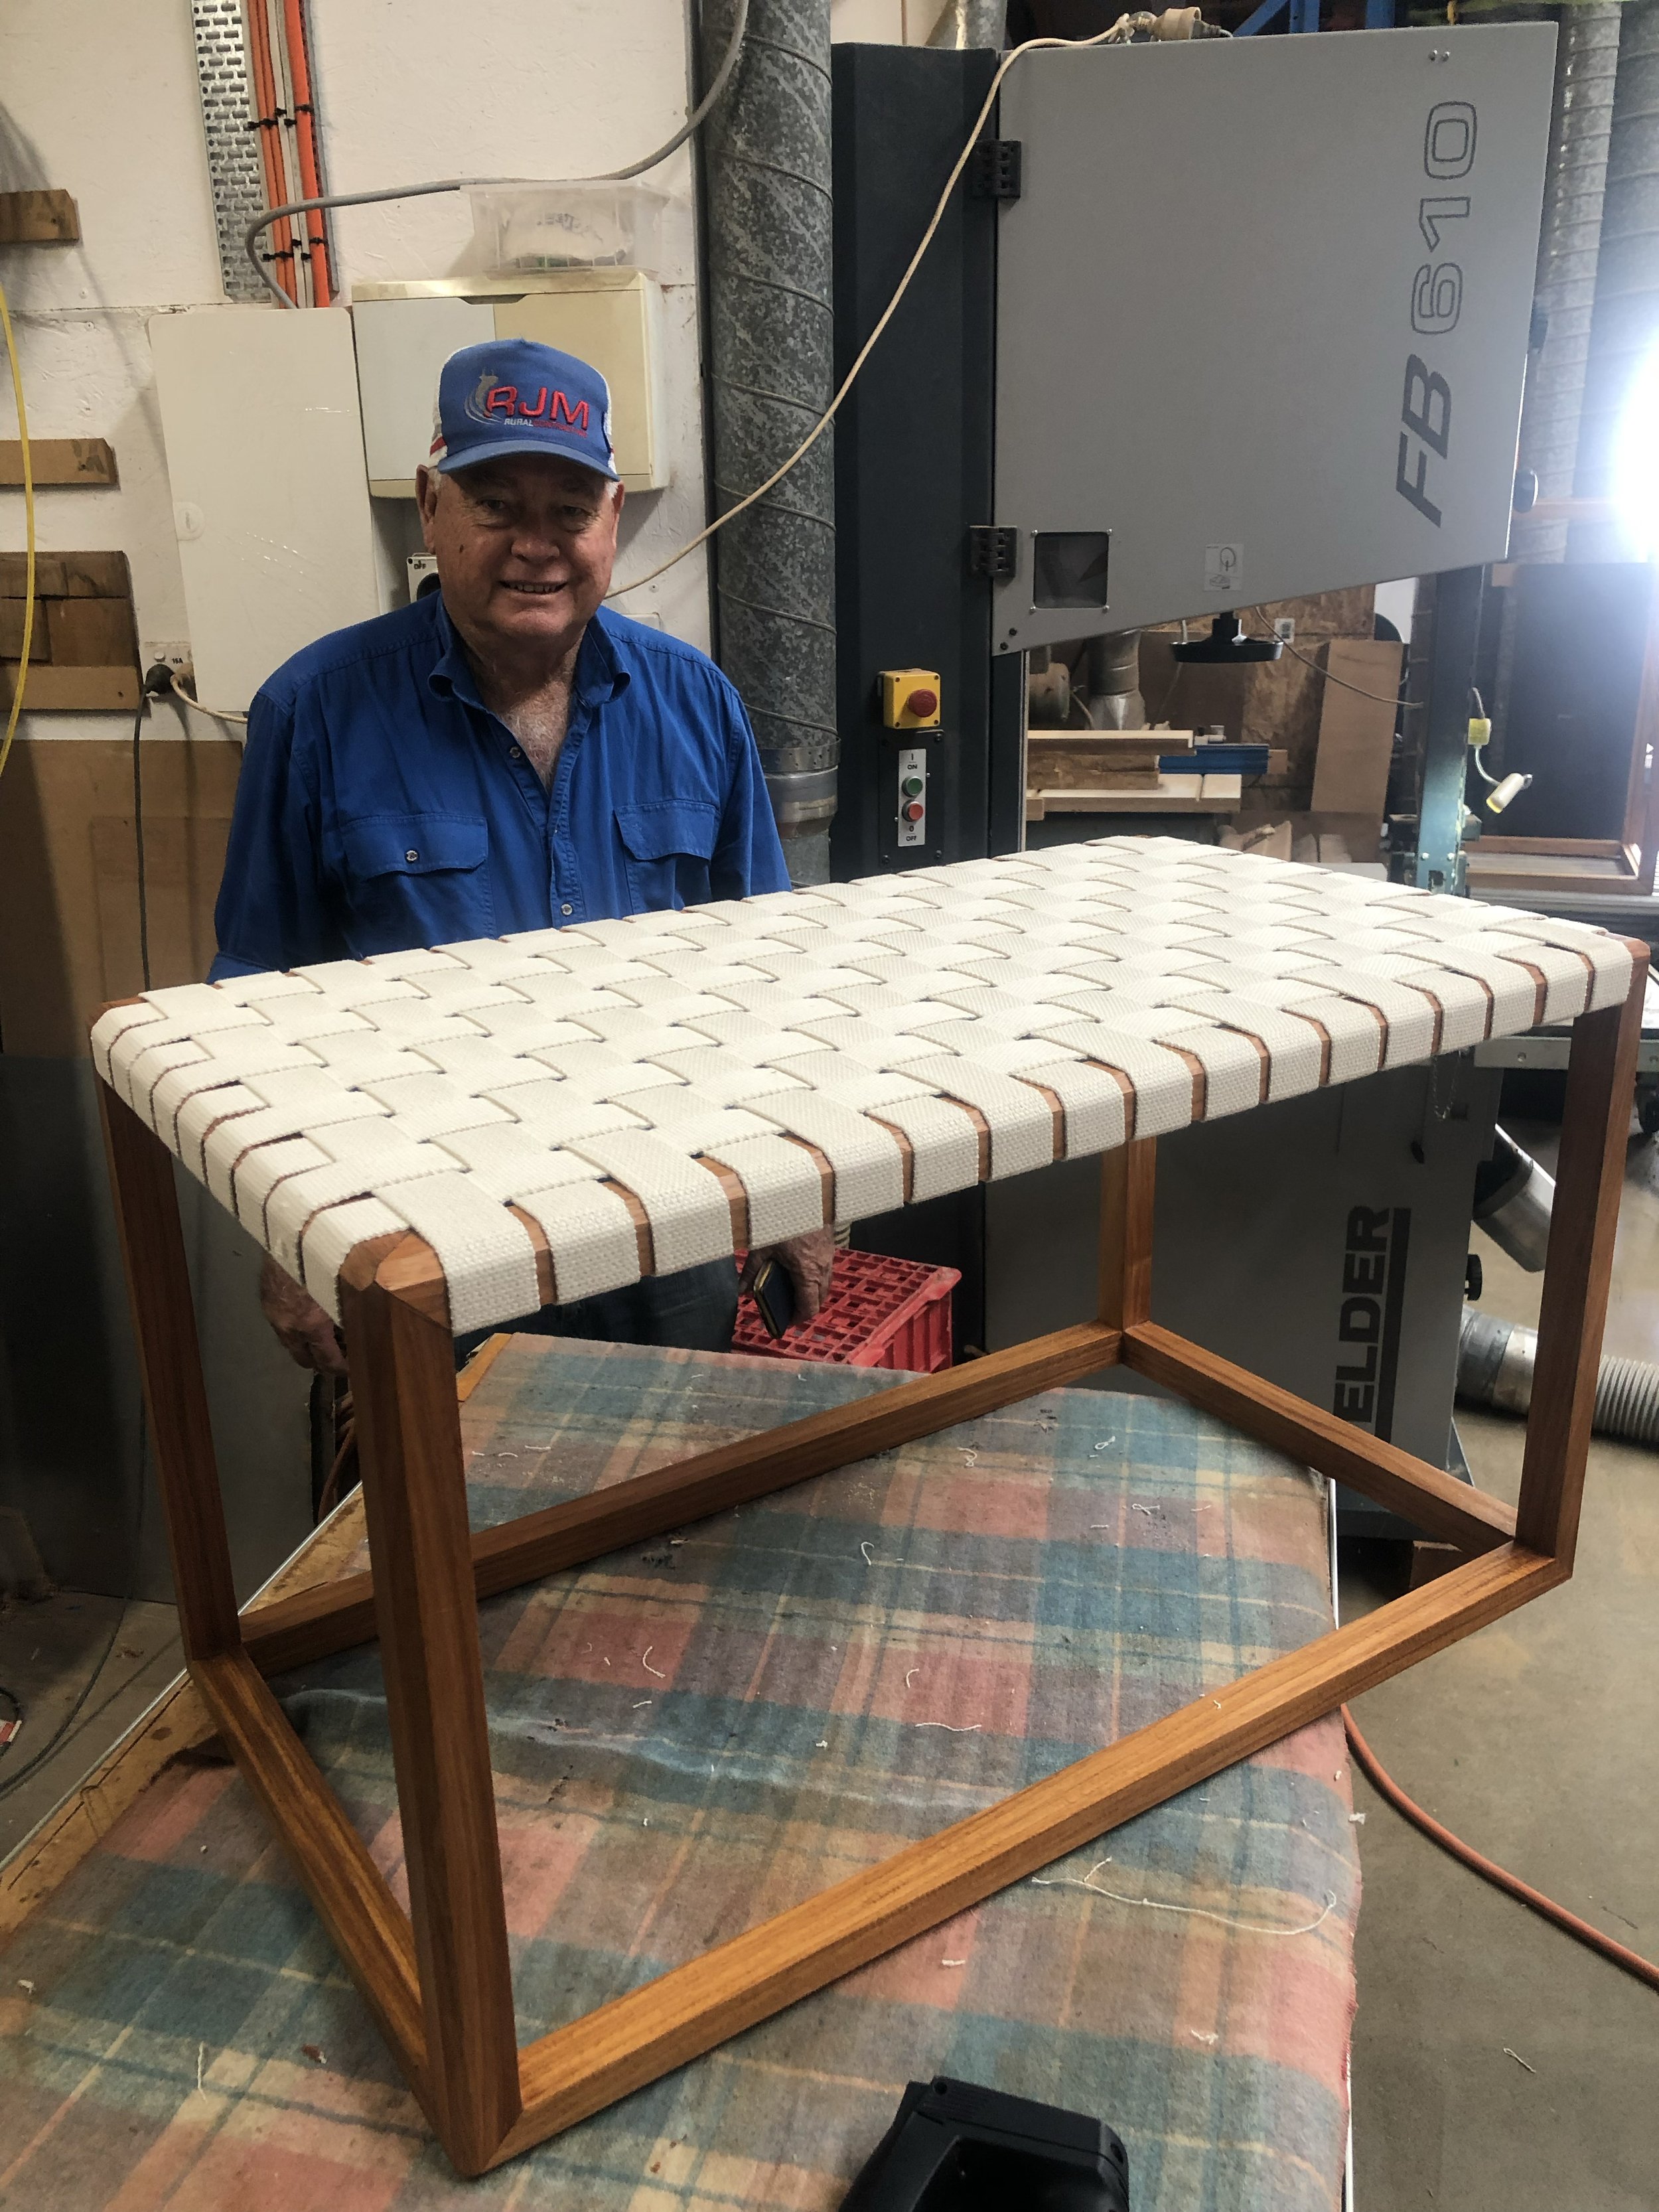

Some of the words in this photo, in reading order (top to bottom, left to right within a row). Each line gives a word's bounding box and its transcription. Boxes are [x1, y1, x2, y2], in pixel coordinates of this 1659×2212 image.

[1411, 101, 1477, 335] 610
[484, 386, 589, 431] RJM
[1396, 353, 1452, 528] FB
[1333, 1205, 1390, 1423] ELDER
